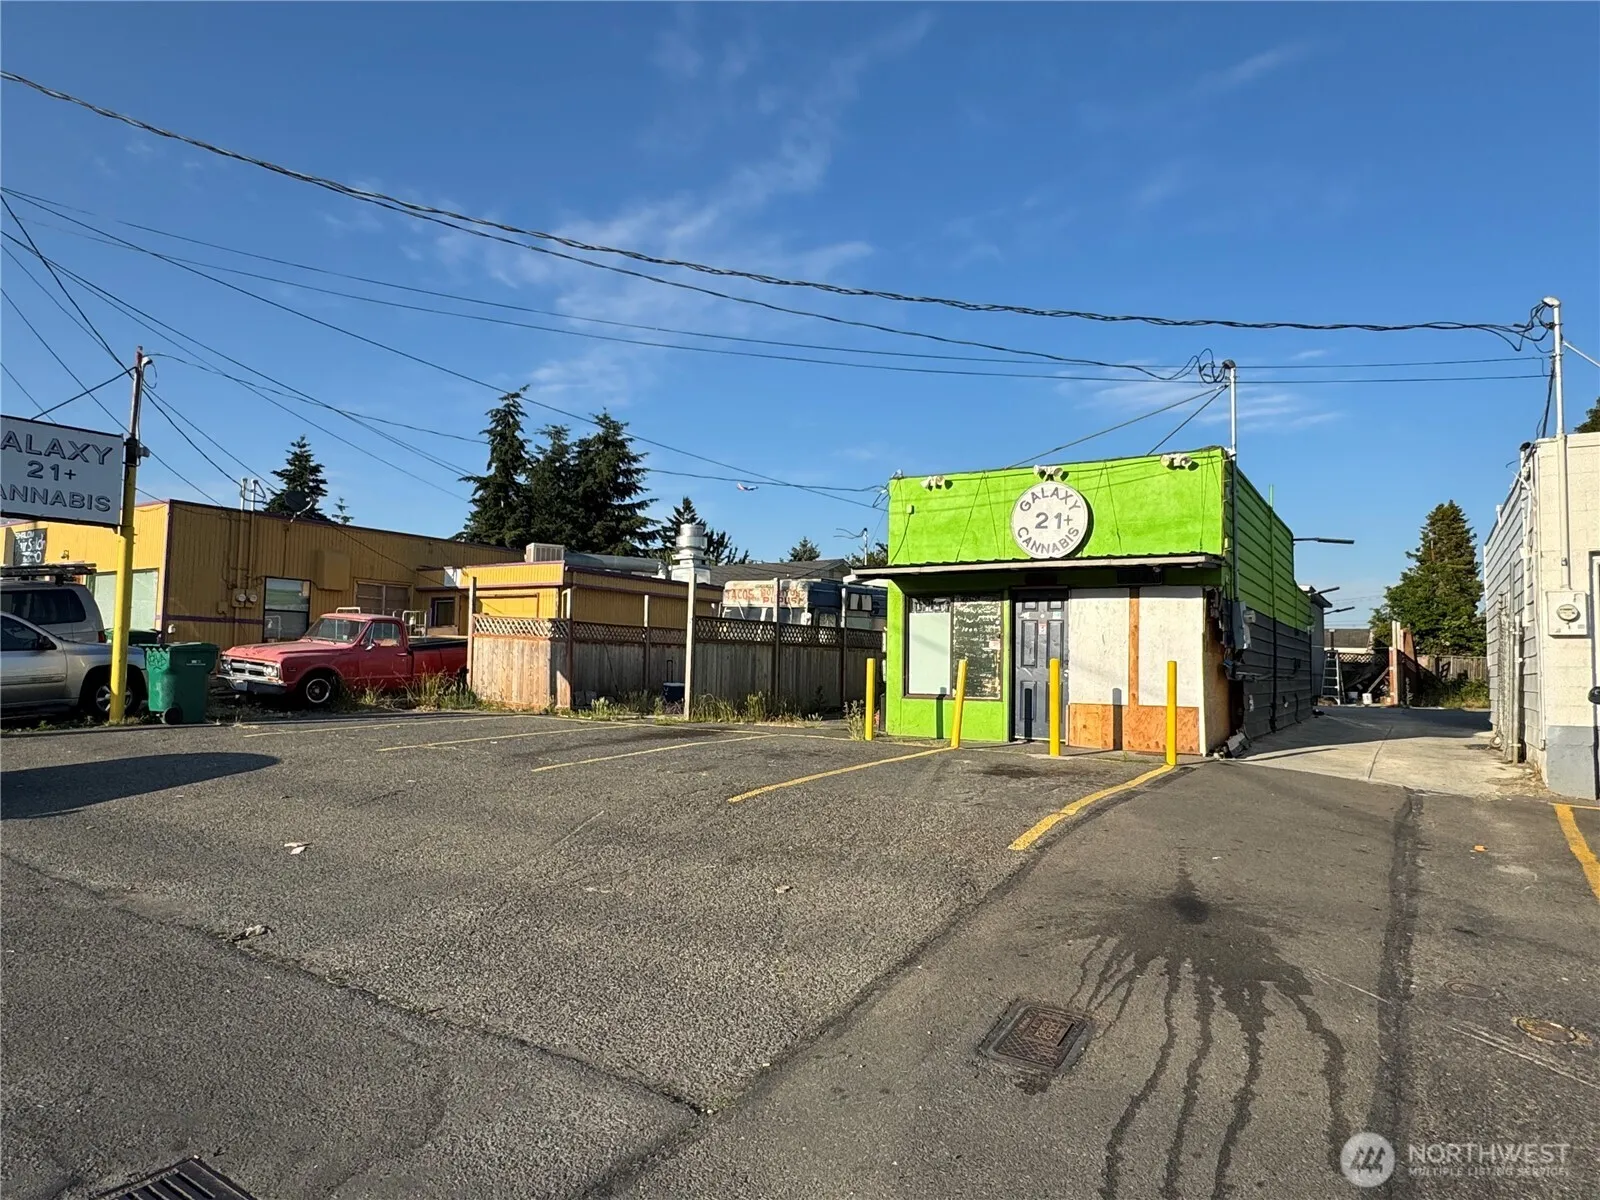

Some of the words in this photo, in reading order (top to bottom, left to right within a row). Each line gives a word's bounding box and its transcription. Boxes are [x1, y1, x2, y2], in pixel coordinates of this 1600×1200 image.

[27, 460, 76, 481] 21+
[1019, 486, 1081, 512] GALAXY
[1035, 511, 1073, 530] 21+
[1017, 526, 1080, 554] CANNABIS
[725, 589, 754, 601] TACOS
